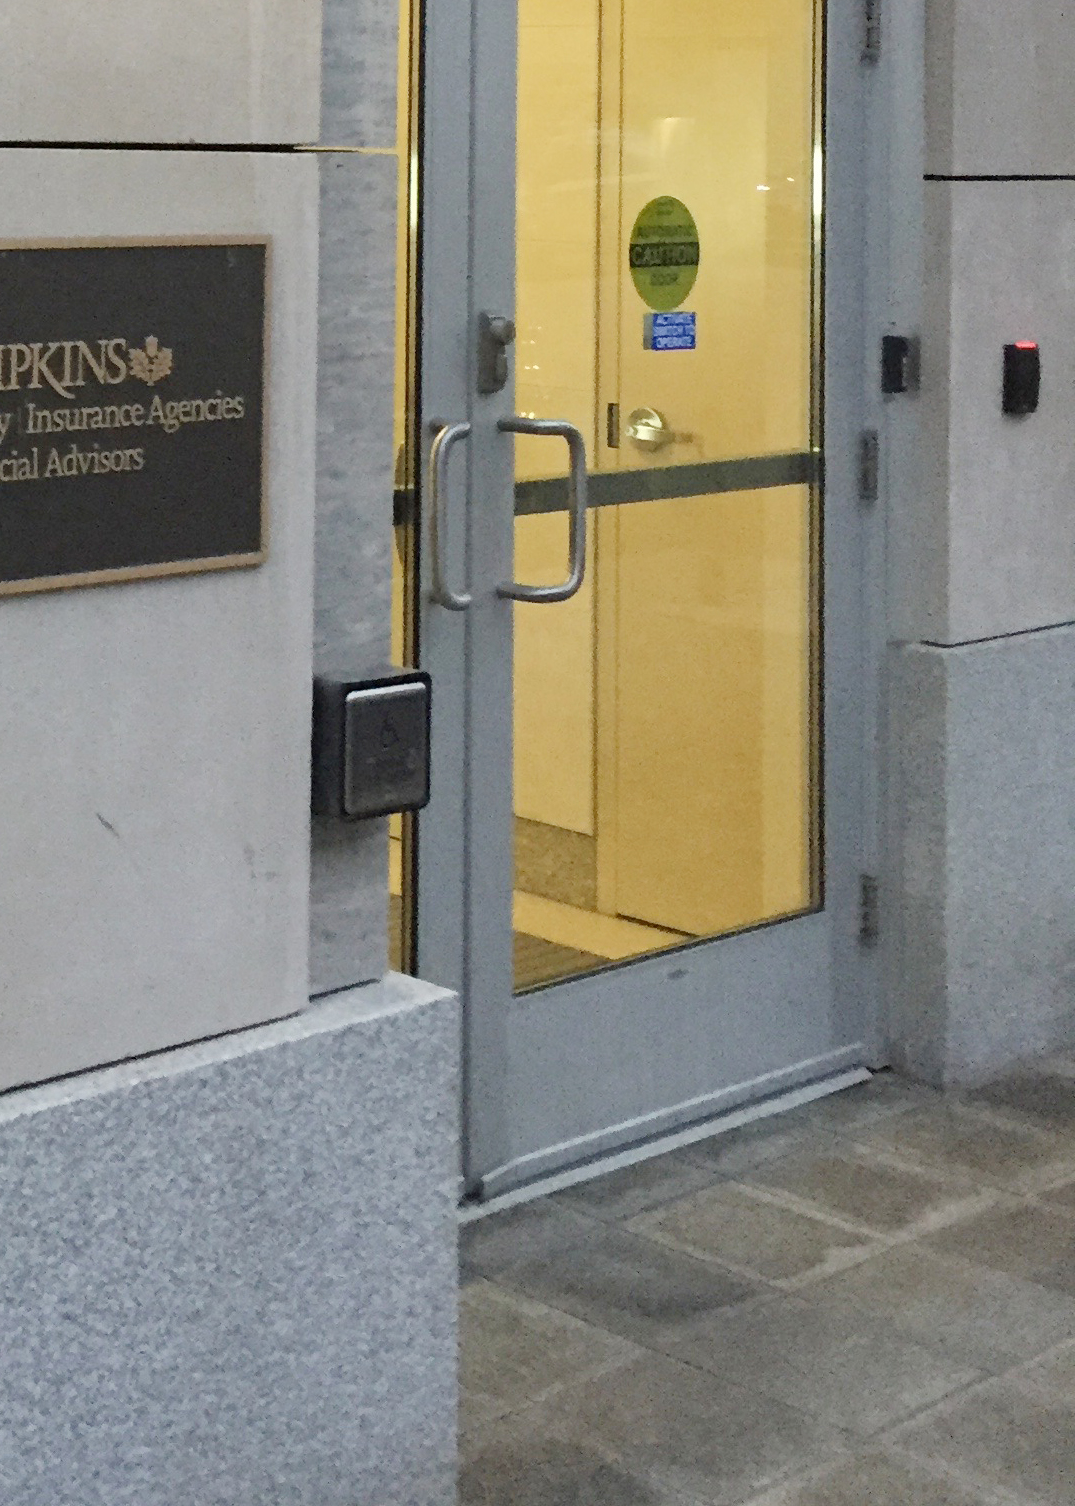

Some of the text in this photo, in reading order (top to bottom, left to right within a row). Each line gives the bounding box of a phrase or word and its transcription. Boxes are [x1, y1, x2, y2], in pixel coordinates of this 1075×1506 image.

[632, 244, 698, 266] CAUTION
[25, 402, 145, 434] Insurance
[146, 389, 245, 433] Agencies
[43, 443, 145, 478] Advisors
